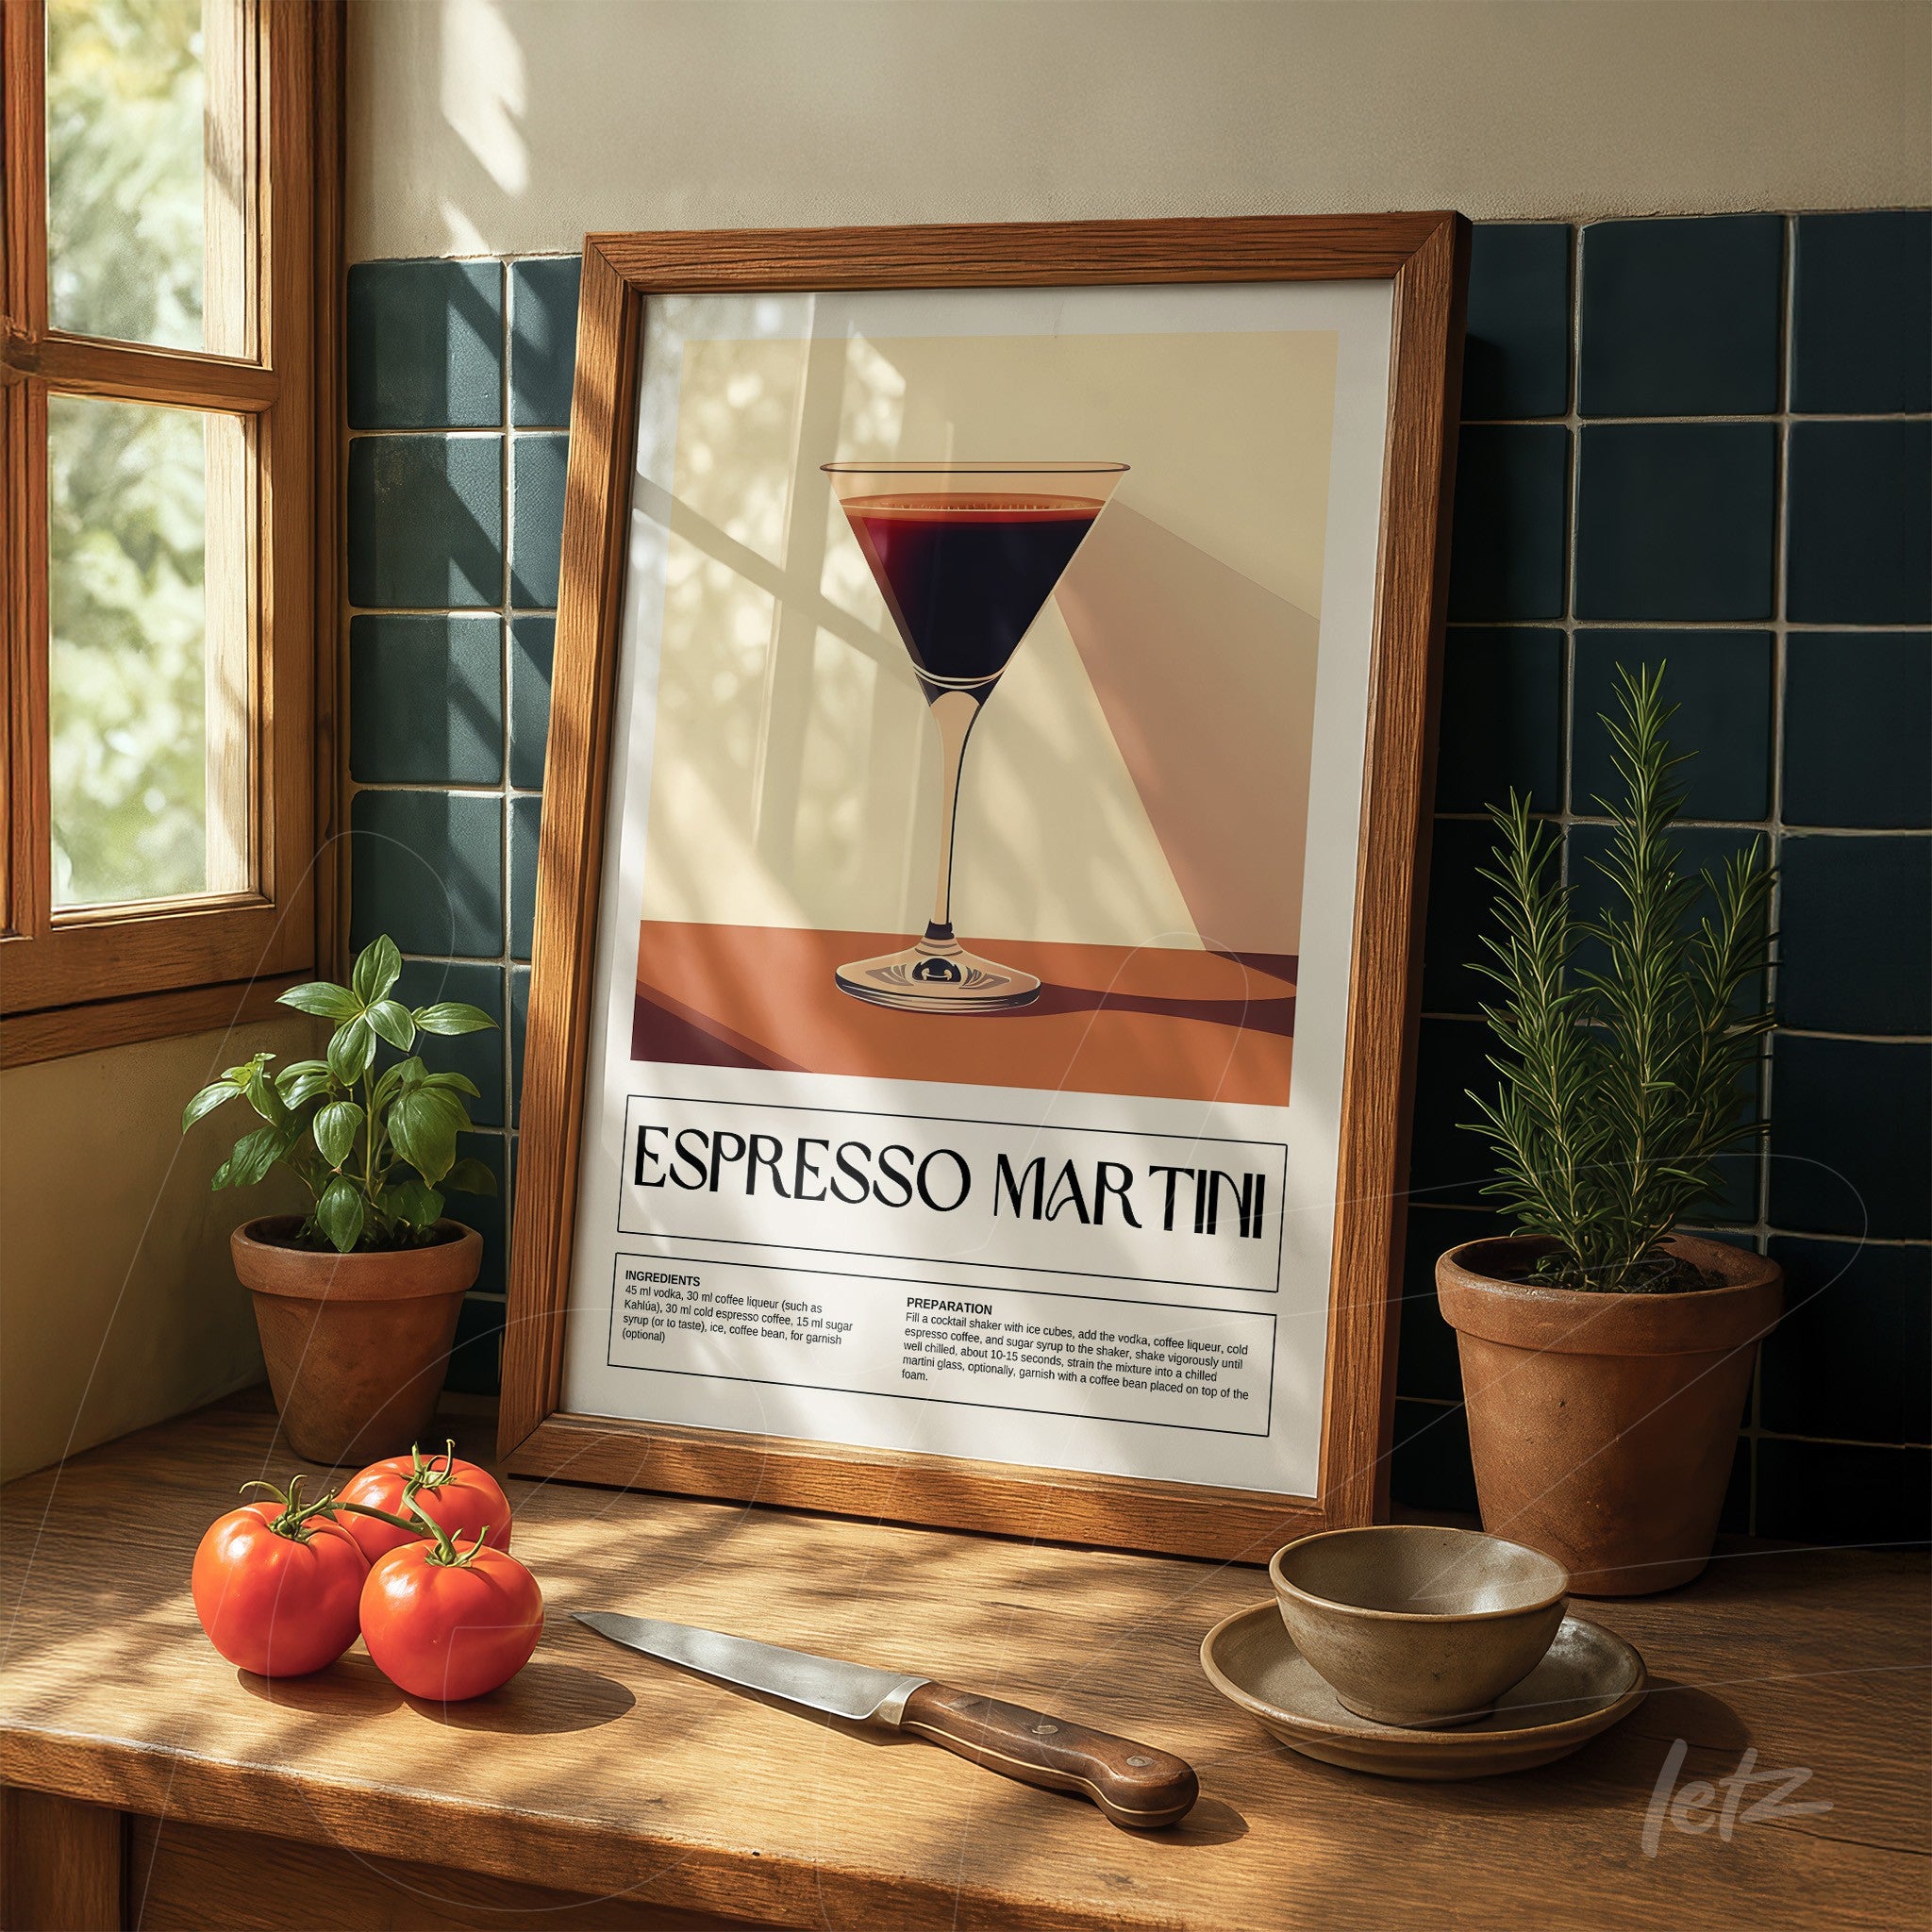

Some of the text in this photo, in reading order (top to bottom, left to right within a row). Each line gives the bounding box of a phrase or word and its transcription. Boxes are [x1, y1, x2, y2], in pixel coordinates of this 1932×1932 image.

[634, 1125, 1266, 1240] ESPRESSO MARTINI
[625, 1270, 700, 1287] INGREDIENTS
[625, 1284, 823, 1314] 45 ml vodka, 30 ml coffee liqueur (such as
[907, 1296, 992, 1315] PREPARATION
[623, 1314, 841, 1345] syrup (or to taste), ice, coffee bean, for garnish
[624, 1299, 663, 1314] Kahlúa),
[665, 1302, 678, 1314] 30
[679, 1304, 691, 1315] ml
[693, 1305, 714, 1318] cold
[715, 1309, 759, 1323] espresso
[796, 1316, 809, 1327] 15
[810, 1318, 824, 1328] ml
[824, 1321, 853, 1333] sugar
[622, 1327, 665, 1343] (optional)
[904, 1327, 1243, 1370] espresso coffee, and sugar syrup to the shaker, shake vigorously until
[906, 1311, 1249, 1356] Fill a cocktail shaker with ice cubes, add the vodka, coffee liqueur, cold
[901, 1368, 928, 1381] foam.
[903, 1341, 1218, 1382] well chilled, about 10-15 seconds, strain the mixture into a chilled
[902, 1356, 1249, 1401] martini glass, optionally, garnish with a coffee bean placed on top of the
